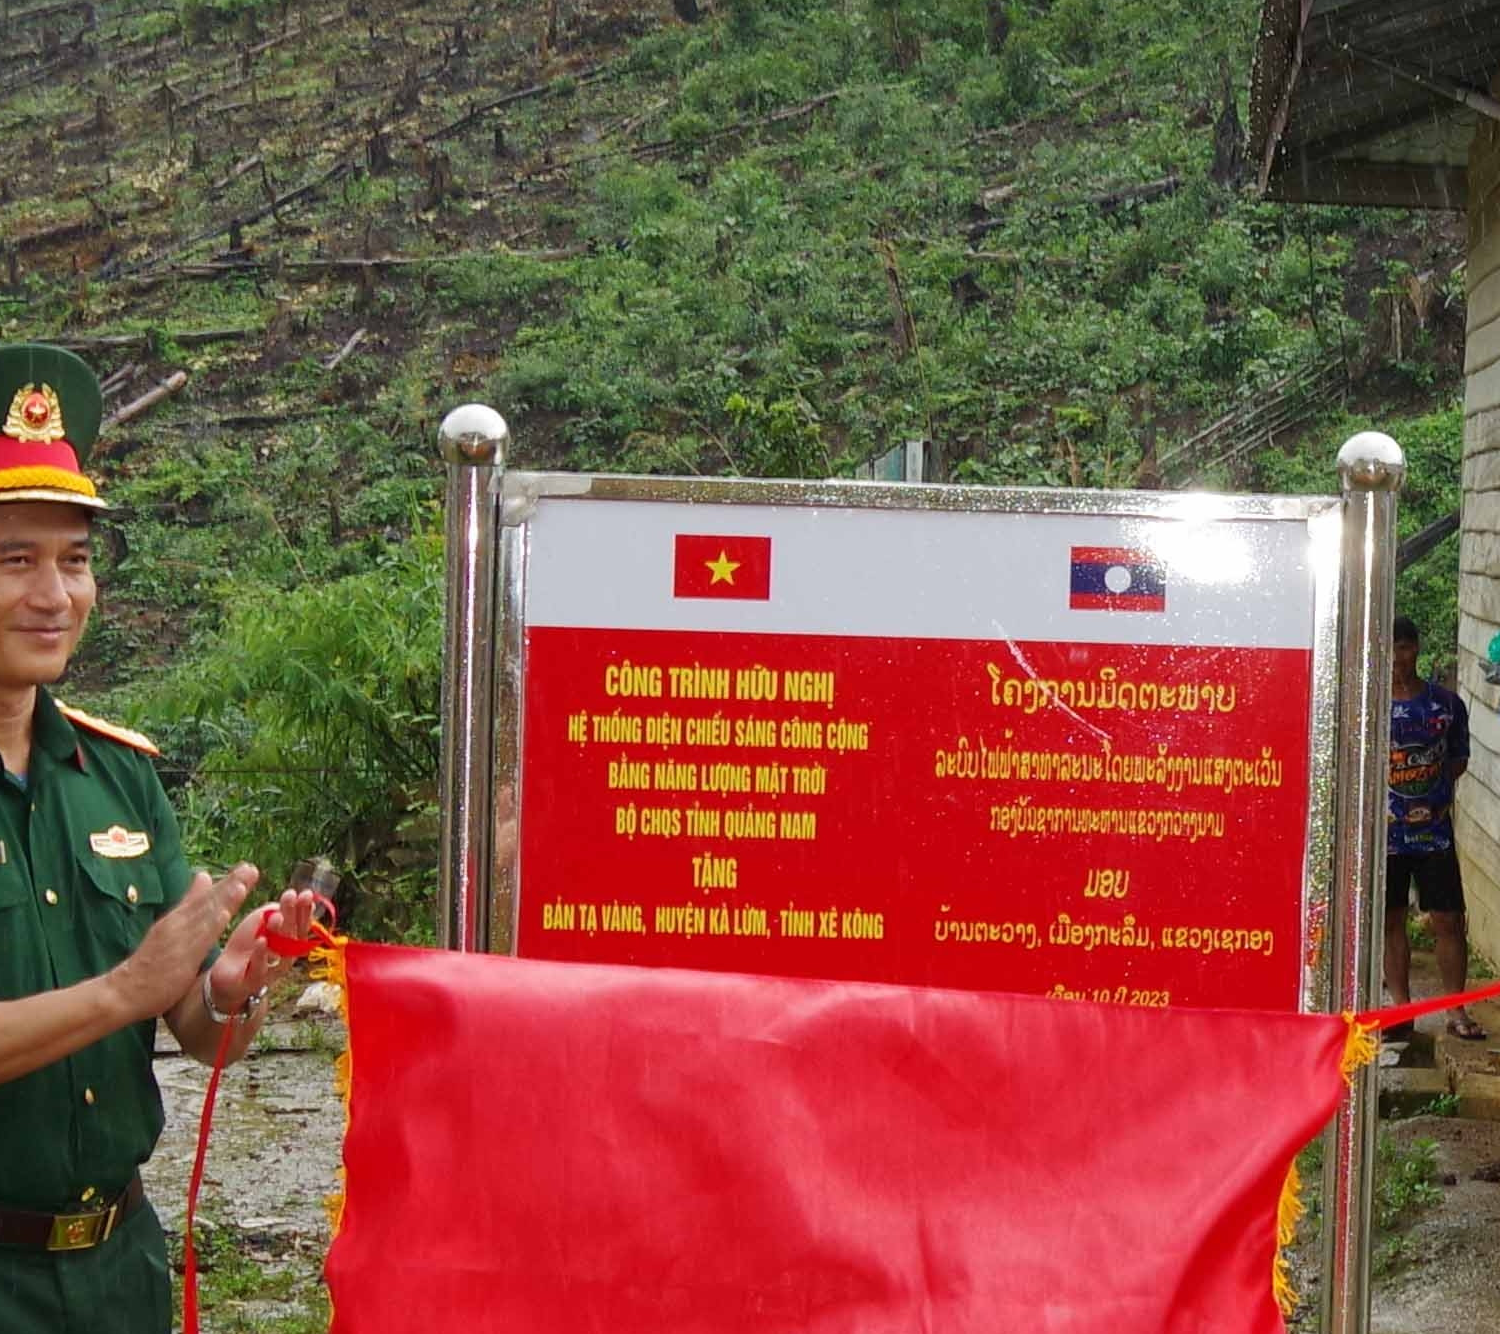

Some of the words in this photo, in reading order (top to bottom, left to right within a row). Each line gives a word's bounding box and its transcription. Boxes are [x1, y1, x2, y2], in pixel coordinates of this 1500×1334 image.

[605, 659, 662, 697] CÔNG
[668, 663, 730, 699] TRÌNH
[736, 664, 778, 701] HỮU
[784, 670, 834, 709] NGHỊ
[568, 710, 588, 748] HỆ
[592, 708, 642, 743] THỐNG
[646, 713, 682, 750] ĐIỆN
[686, 712, 731, 746] CHIẾU
[734, 716, 777, 747] SÁNG
[780, 717, 823, 749] CÔNG
[826, 717, 868, 755] CỘNG
[608, 753, 650, 789] BẰNG
[654, 759, 697, 791] NĂNG
[701, 763, 751, 796] LƯỢNG
[755, 762, 788, 799] MẶT
[792, 761, 827, 795] TRỜI
[616, 803, 637, 839] BỘ
[640, 808, 681, 838] CHQS
[685, 802, 720, 837] TỈNH
[724, 803, 776, 840] QUẢNG
[780, 811, 816, 840] NAM
[692, 852, 737, 894] TẶNG
[579, 904, 597, 936] TẠ
[655, 902, 705, 938] HUYỆN
[780, 901, 814, 937] TỈNH
[842, 909, 883, 939] KÔNG
[1129, 990, 1170, 1008] 2023
